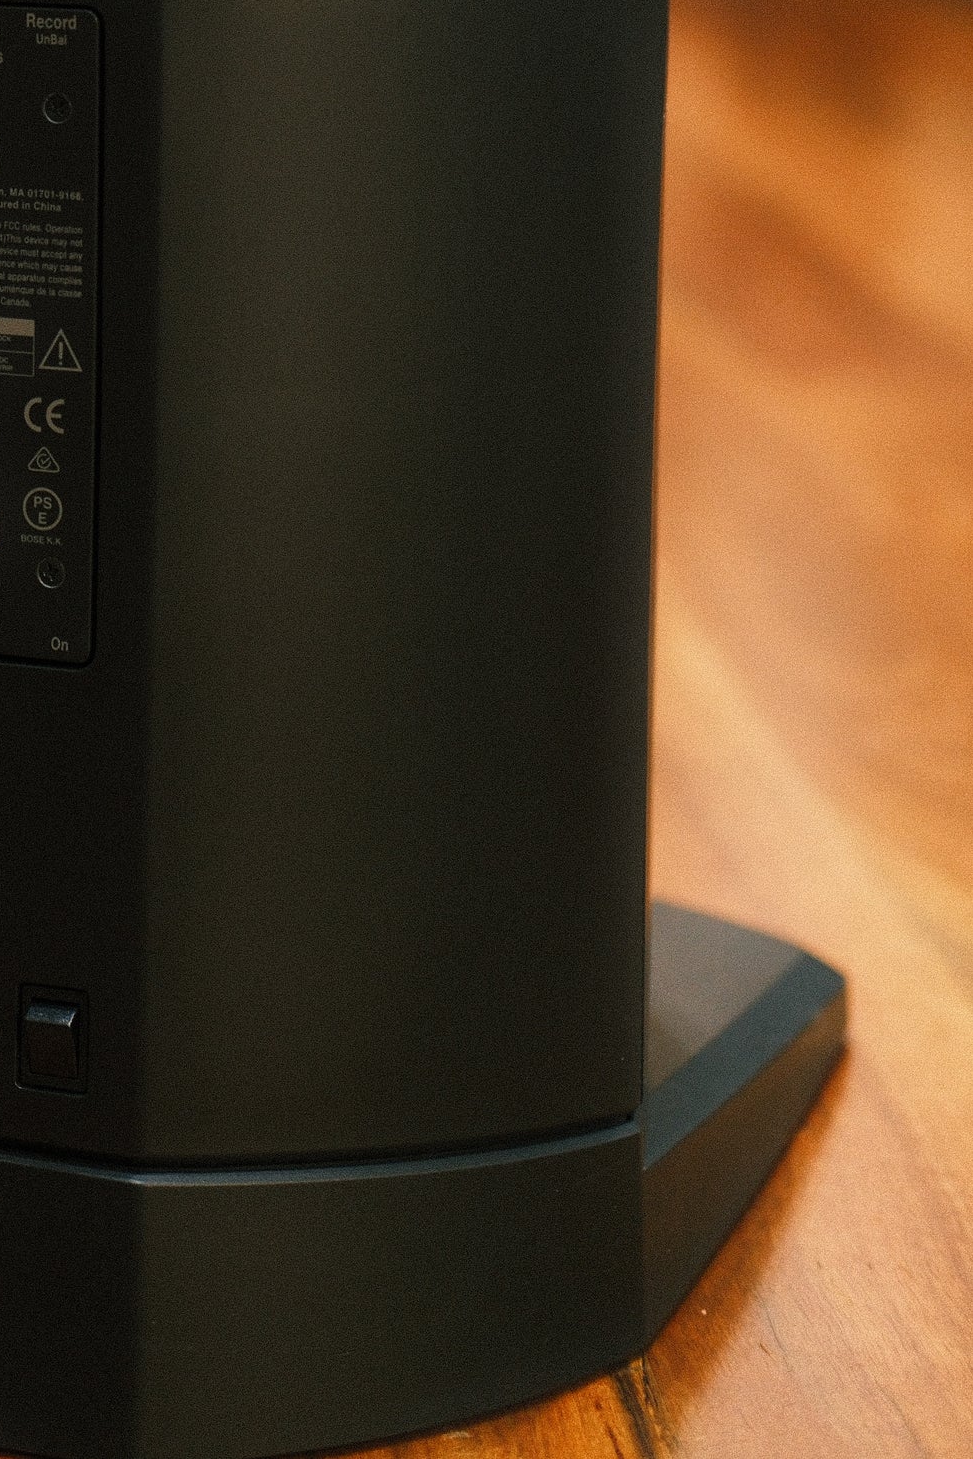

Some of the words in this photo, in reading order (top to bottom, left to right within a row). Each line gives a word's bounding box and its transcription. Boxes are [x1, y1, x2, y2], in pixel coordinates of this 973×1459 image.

[26, 13, 77, 30] Record
[36, 34, 68, 46] UnBal
[10, 188, 24, 197] MA
[22, 201, 30, 209] in
[34, 202, 61, 212] China
[4, 221, 20, 230] FCC
[45, 224, 83, 234] Operation
[24, 236, 49, 245] device
[51, 239, 67, 248] may
[70, 239, 83, 247] not
[20, 249, 39, 257] must
[41, 251, 67, 259] accept
[69, 252, 83, 261] any
[18, 260, 39, 270] which
[42, 263, 57, 273] may
[60, 264, 82, 272] cause
[8, 273, 45, 283] apparatus
[48, 276, 82, 285] complies
[37, 286, 46, 295] de
[49, 288, 56, 296] la
[58, 289, 82, 298] classe
[24, 397, 65, 434] CE
[34, 496, 52, 510] PS
[38, 512, 47, 524] E
[20, 534, 44, 544] BOSE
[51, 636, 69, 651] On
